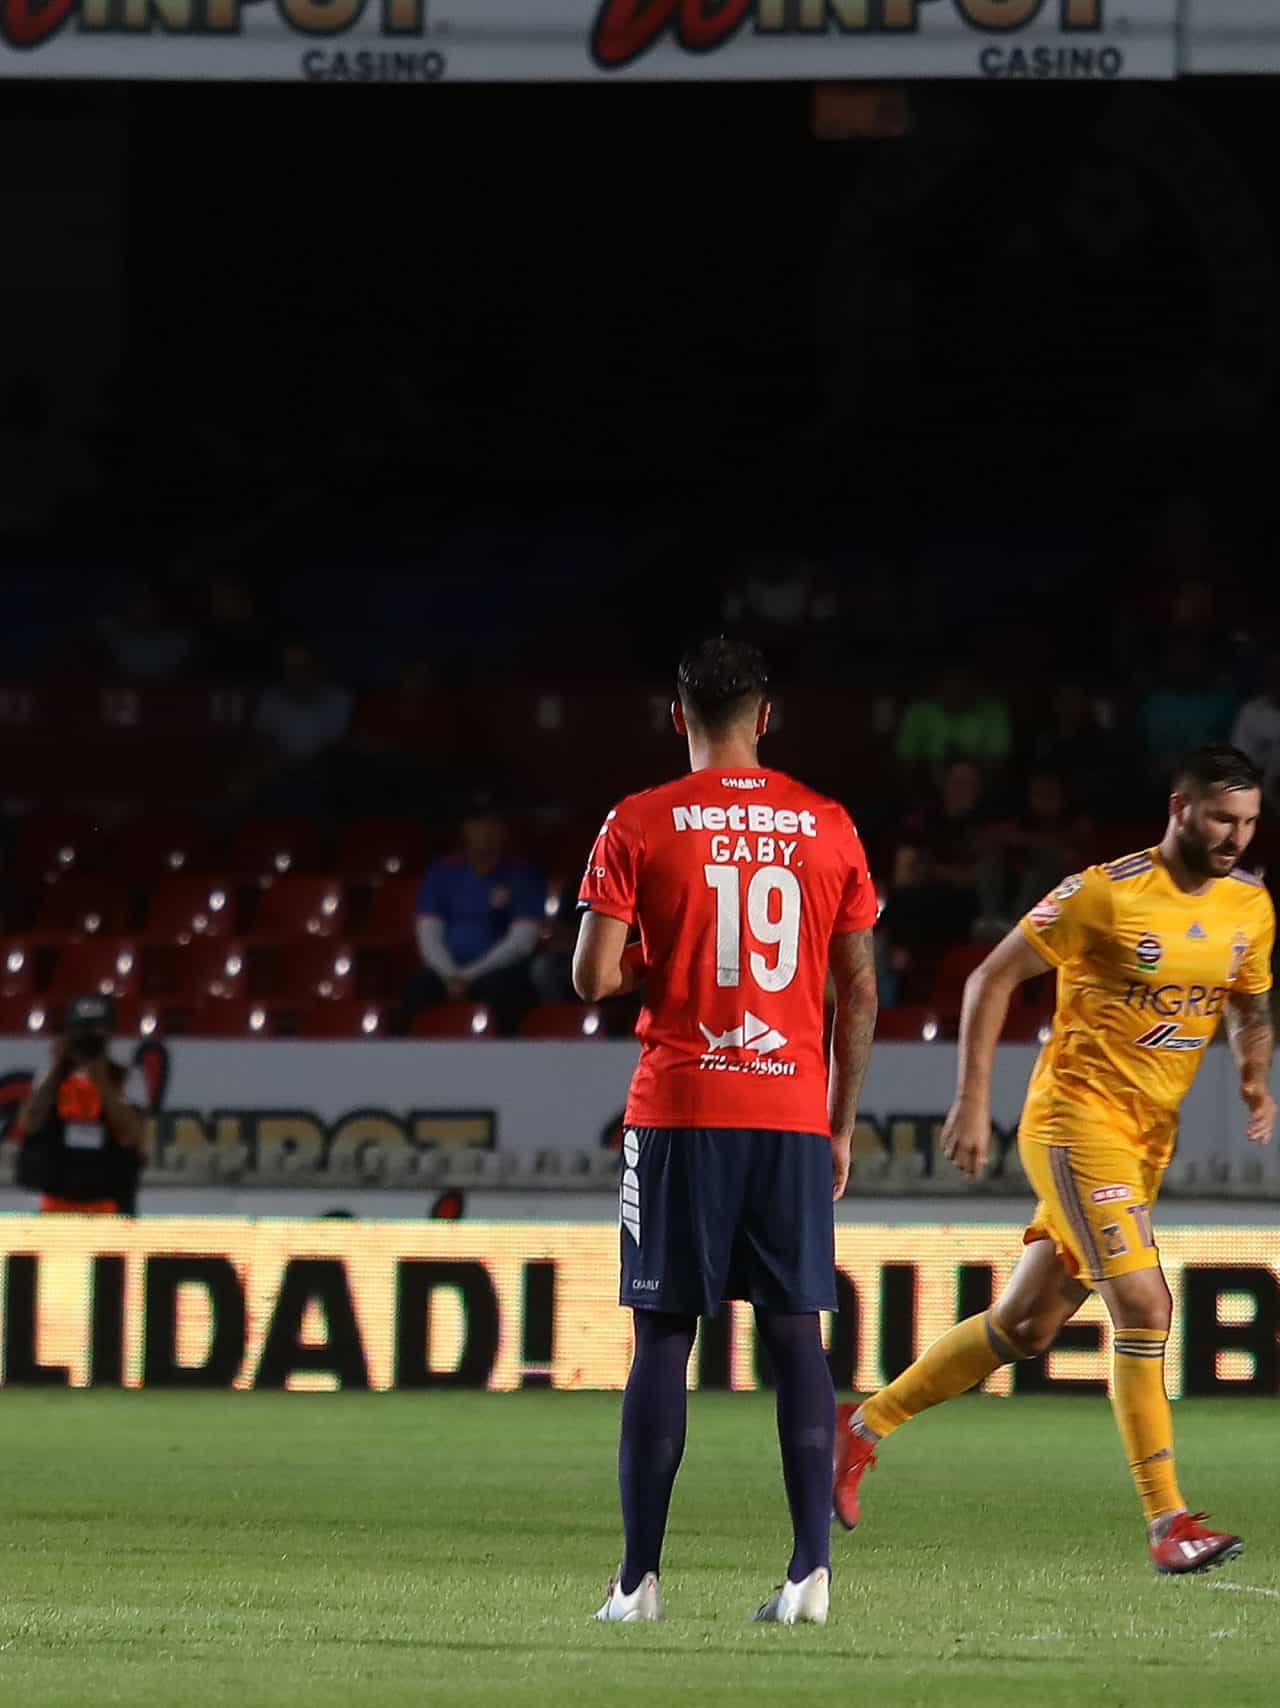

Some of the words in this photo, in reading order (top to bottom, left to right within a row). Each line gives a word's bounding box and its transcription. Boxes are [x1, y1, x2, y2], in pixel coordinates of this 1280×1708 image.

[302, 50, 446, 82] CASINO
[979, 46, 1123, 78] CASINO
[672, 804, 817, 837] NetBet
[711, 834, 798, 866] GABY
[704, 864, 802, 993] 19
[4, 1252, 557, 1389] LIDAD!
